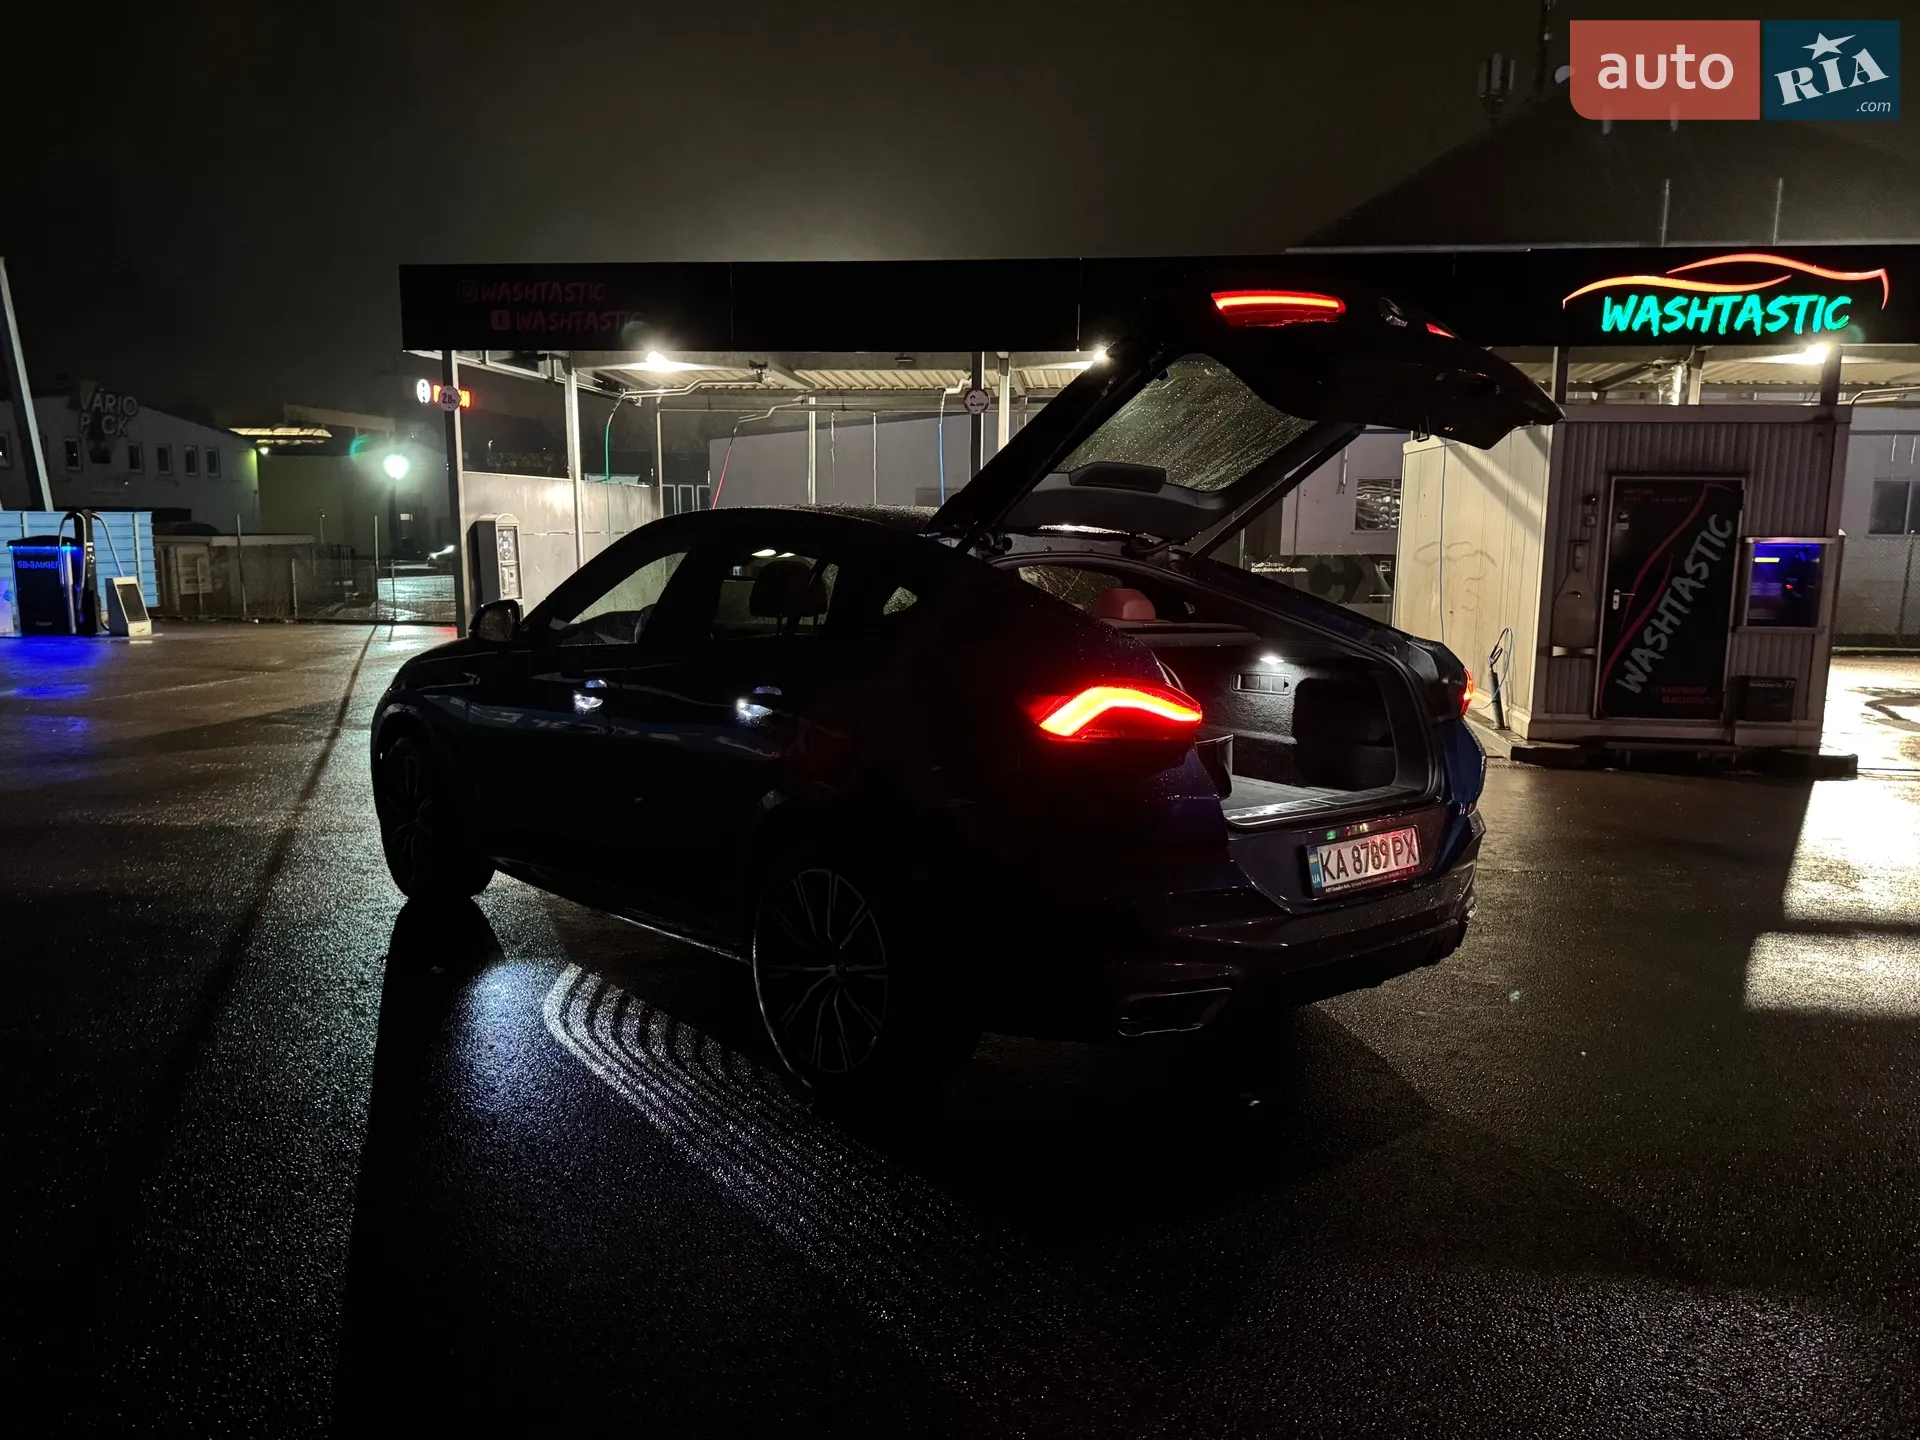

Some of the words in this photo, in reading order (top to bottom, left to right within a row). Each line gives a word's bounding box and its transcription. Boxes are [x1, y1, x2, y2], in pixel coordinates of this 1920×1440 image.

[480, 281, 608, 304] WASHTASTIC
[1601, 294, 1852, 336] WASHTASTIC
[80, 412, 128, 437] PCK
[1615, 514, 1733, 694] WASHTASTIC
[1320, 848, 1349, 882] KA
[1352, 838, 1389, 874] 8789
[1391, 827, 1417, 867] PX
[1312, 874, 1320, 883] UA
